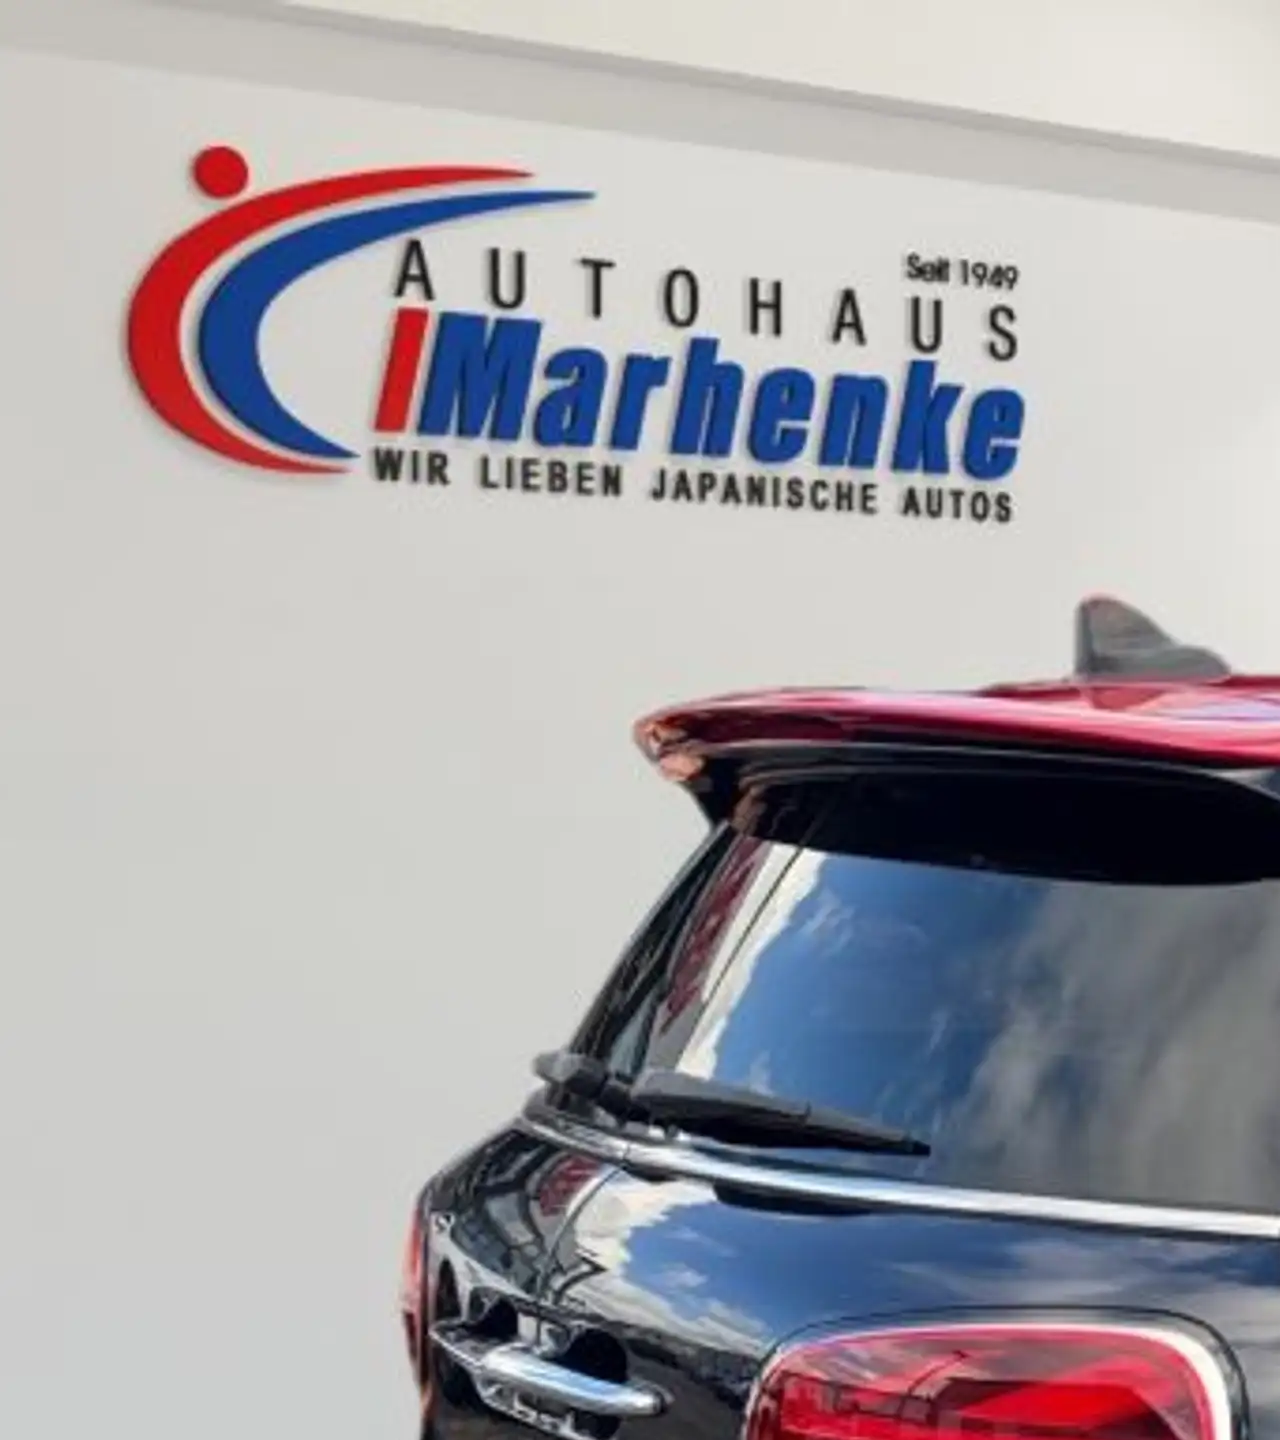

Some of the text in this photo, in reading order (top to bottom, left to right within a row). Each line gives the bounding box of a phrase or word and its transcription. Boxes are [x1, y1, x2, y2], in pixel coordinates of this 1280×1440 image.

[393, 239, 1018, 361] AUTOHAUS
[904, 252, 1019, 290] Seit 1949
[374, 446, 1013, 524] WIR LIEBEN JAPANISCHE AUTOS
